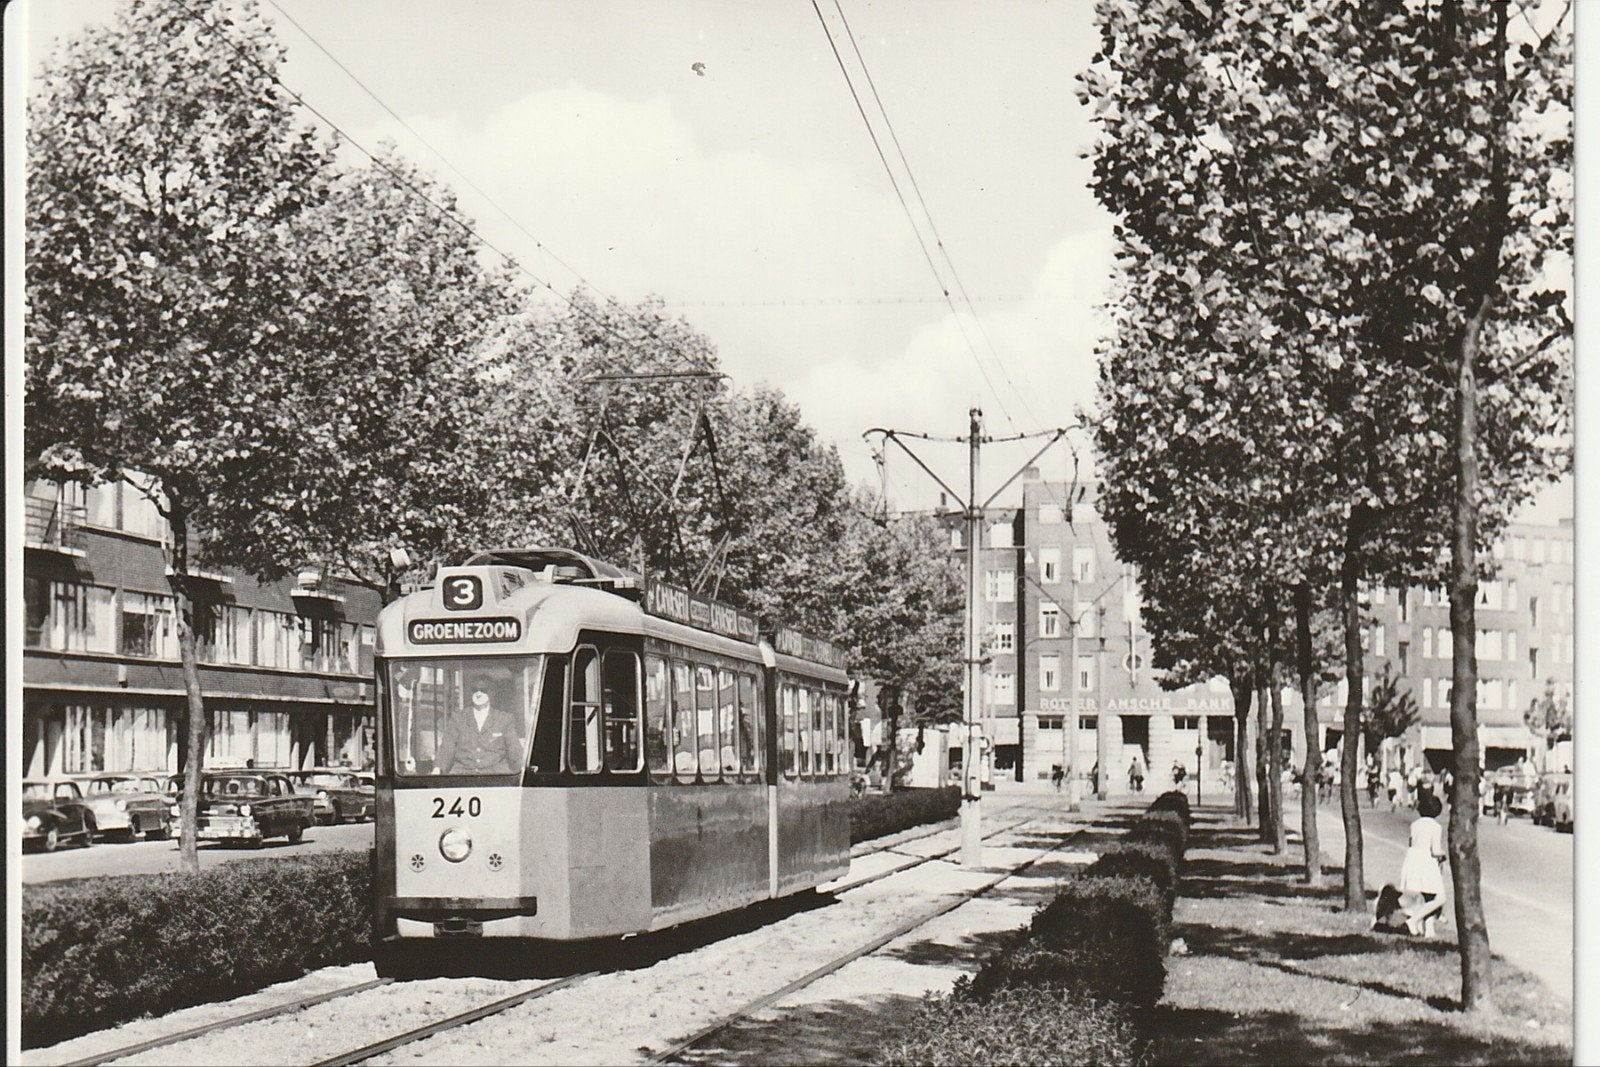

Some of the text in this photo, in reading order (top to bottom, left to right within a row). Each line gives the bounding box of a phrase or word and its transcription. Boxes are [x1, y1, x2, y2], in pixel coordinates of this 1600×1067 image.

[452, 579, 475, 605] 3
[413, 621, 518, 640] GROENEZOOM
[1039, 697, 1231, 710] ROTERAMSCHE BANK
[431, 796, 482, 819] 240
